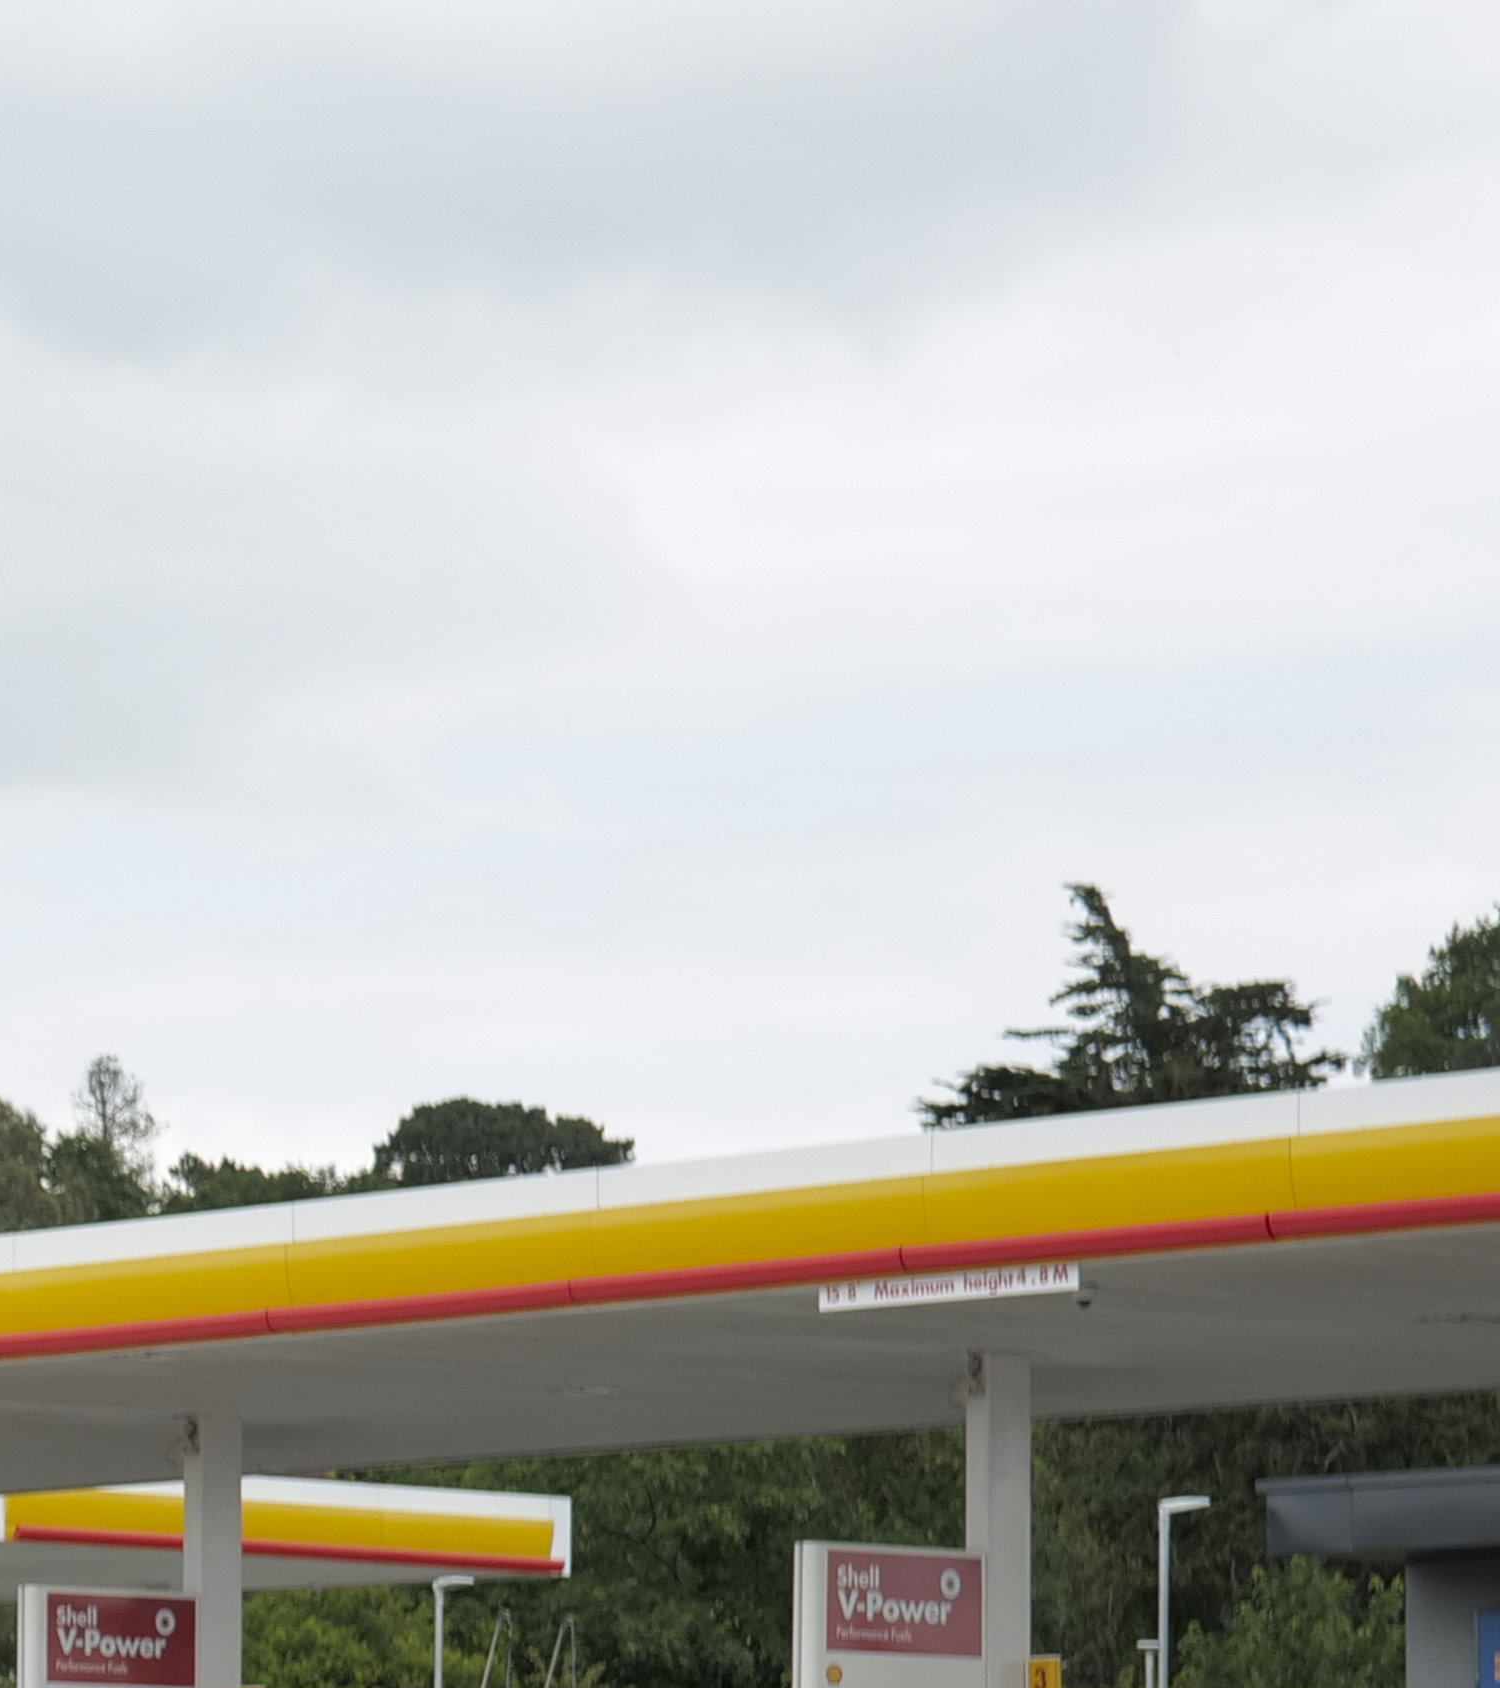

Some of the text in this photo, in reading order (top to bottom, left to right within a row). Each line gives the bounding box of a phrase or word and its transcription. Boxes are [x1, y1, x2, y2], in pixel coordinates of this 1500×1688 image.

[874, 1277, 955, 1300] Maximum
[836, 1563, 881, 1590] Shell
[56, 1603, 98, 1628] Shell
[837, 1588, 952, 1626] V-Power
[56, 1627, 167, 1660] V-Power
